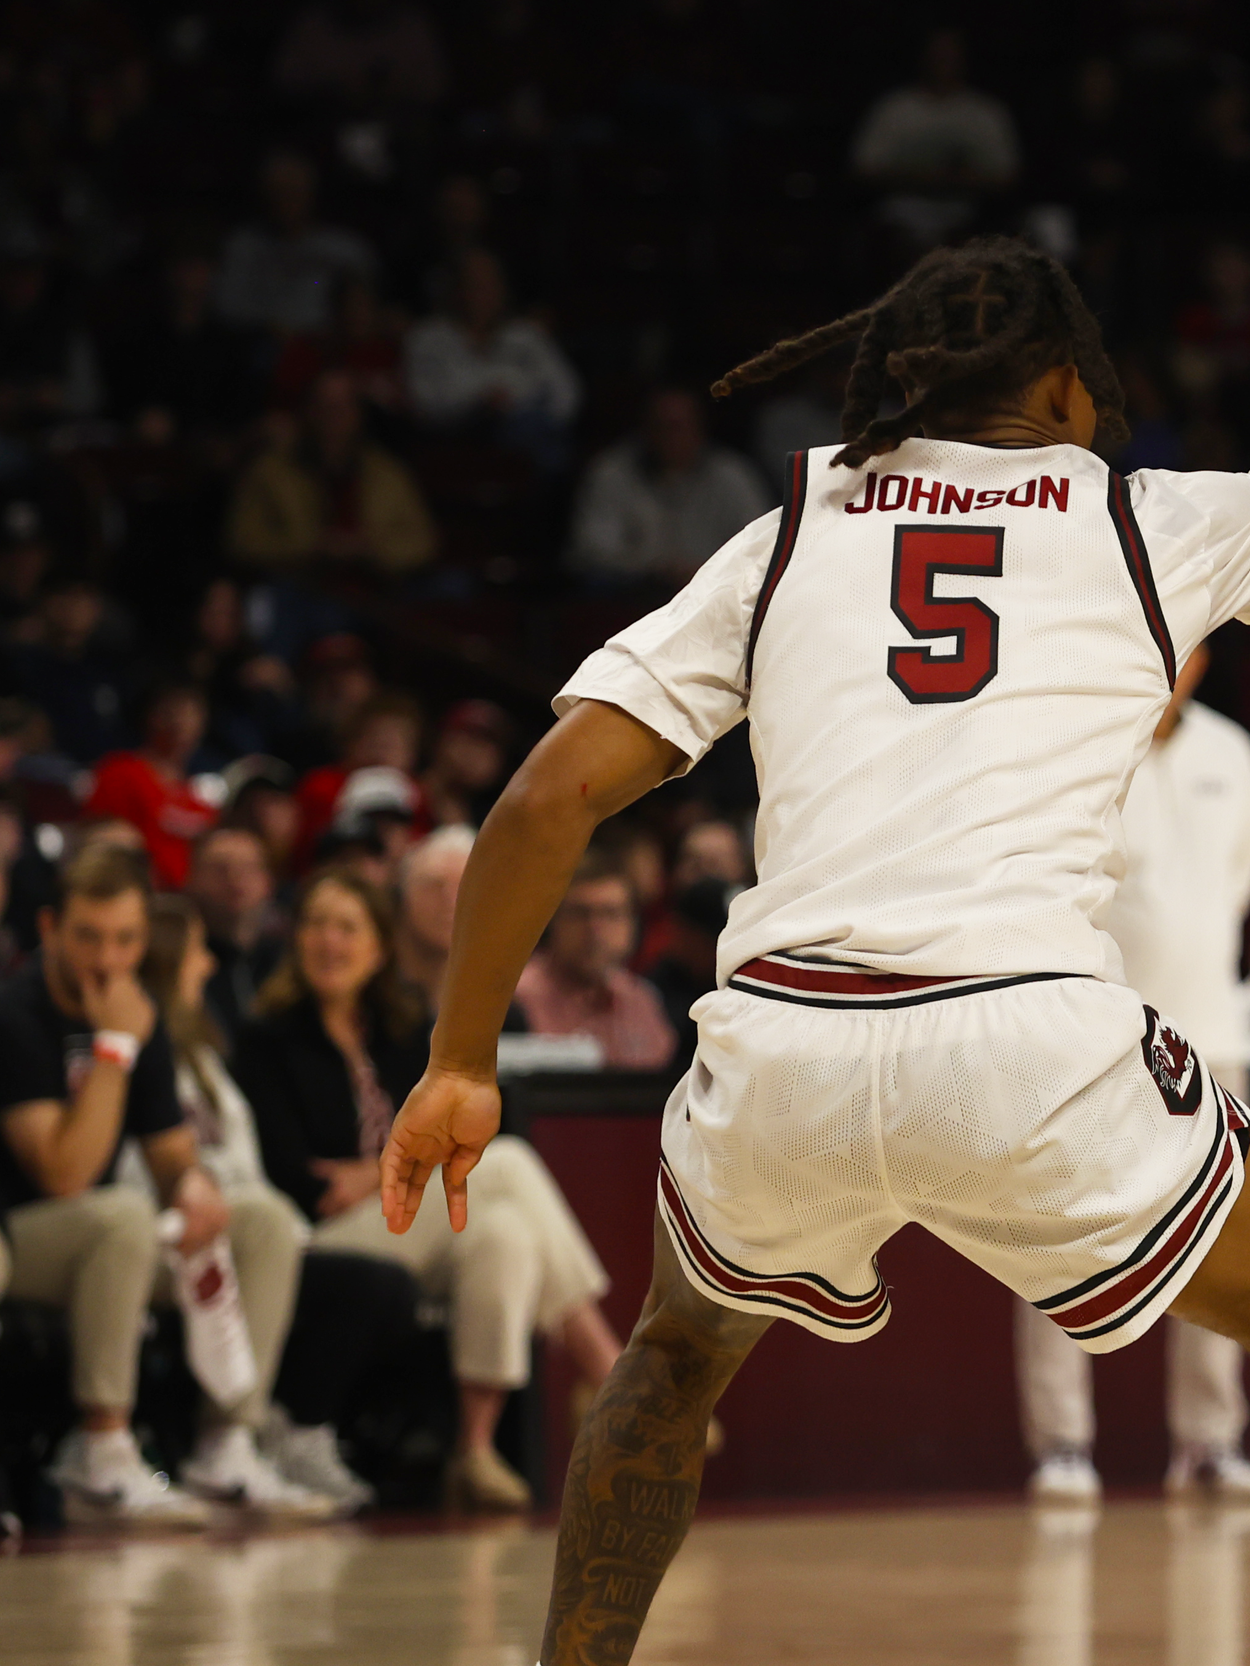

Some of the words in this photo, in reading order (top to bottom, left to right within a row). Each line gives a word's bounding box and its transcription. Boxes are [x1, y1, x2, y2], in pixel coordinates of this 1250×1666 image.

[844, 472, 1070, 515] JOHNSON
[887, 523, 1005, 705] 5
[630, 1480, 697, 1519] WALK
[600, 1519, 636, 1552] BY
[603, 1573, 647, 1608] NOT
